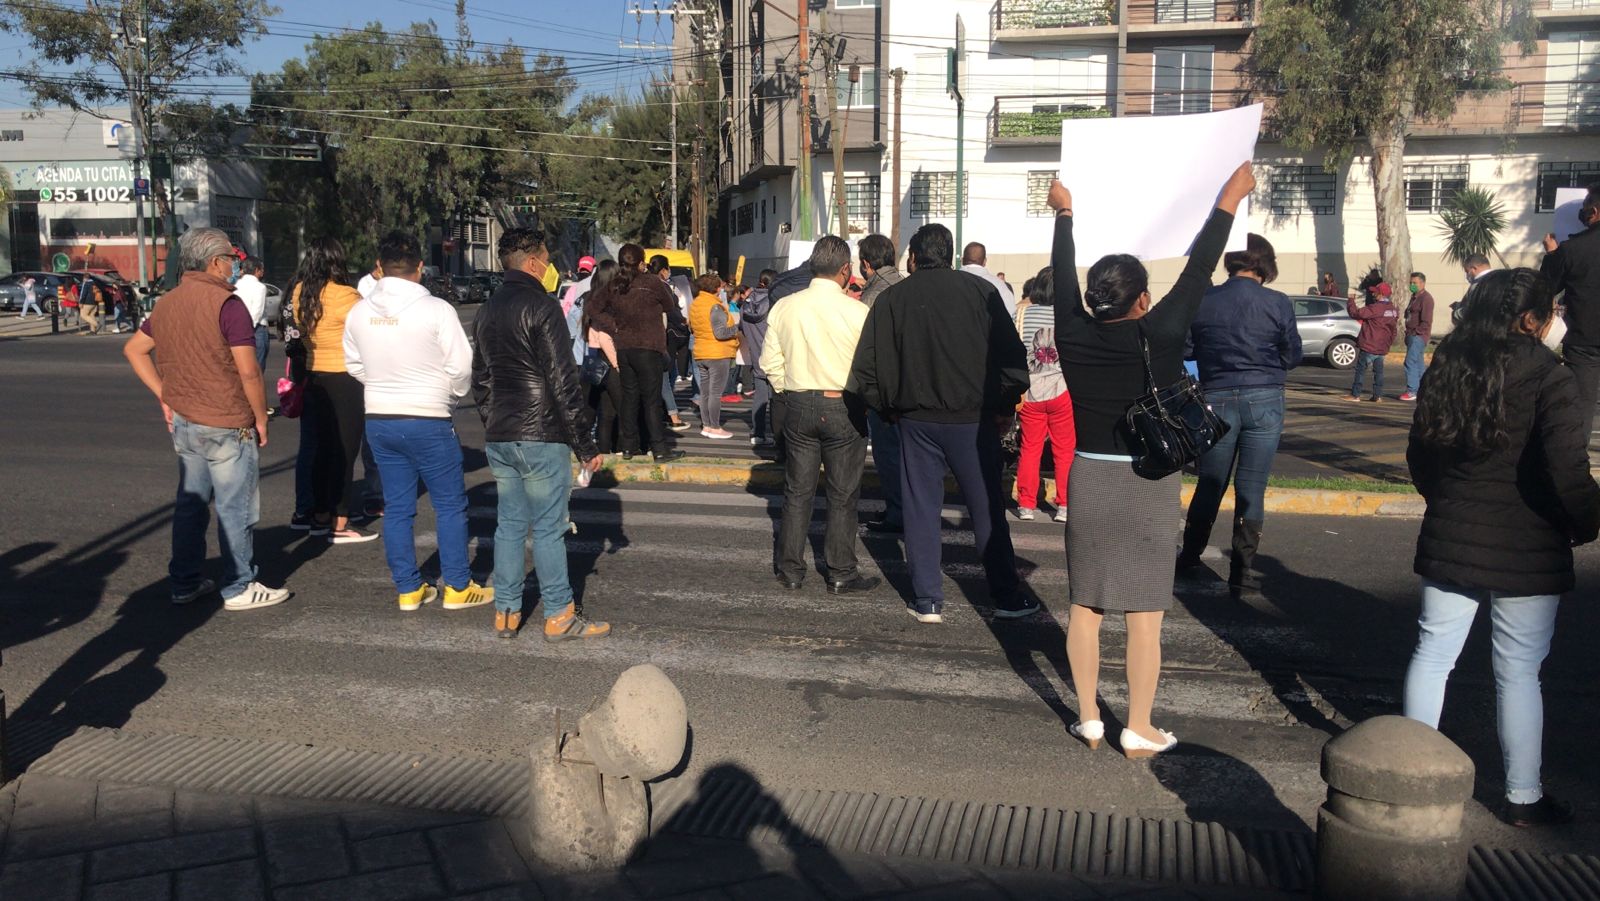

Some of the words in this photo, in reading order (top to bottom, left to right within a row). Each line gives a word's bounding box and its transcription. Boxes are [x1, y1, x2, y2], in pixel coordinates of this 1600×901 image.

[36, 166, 83, 182] AGENDA
[84, 166, 99, 182] TU
[101, 165, 127, 182] CITA
[54, 186, 78, 202] 55
[84, 186, 130, 202] 1002
